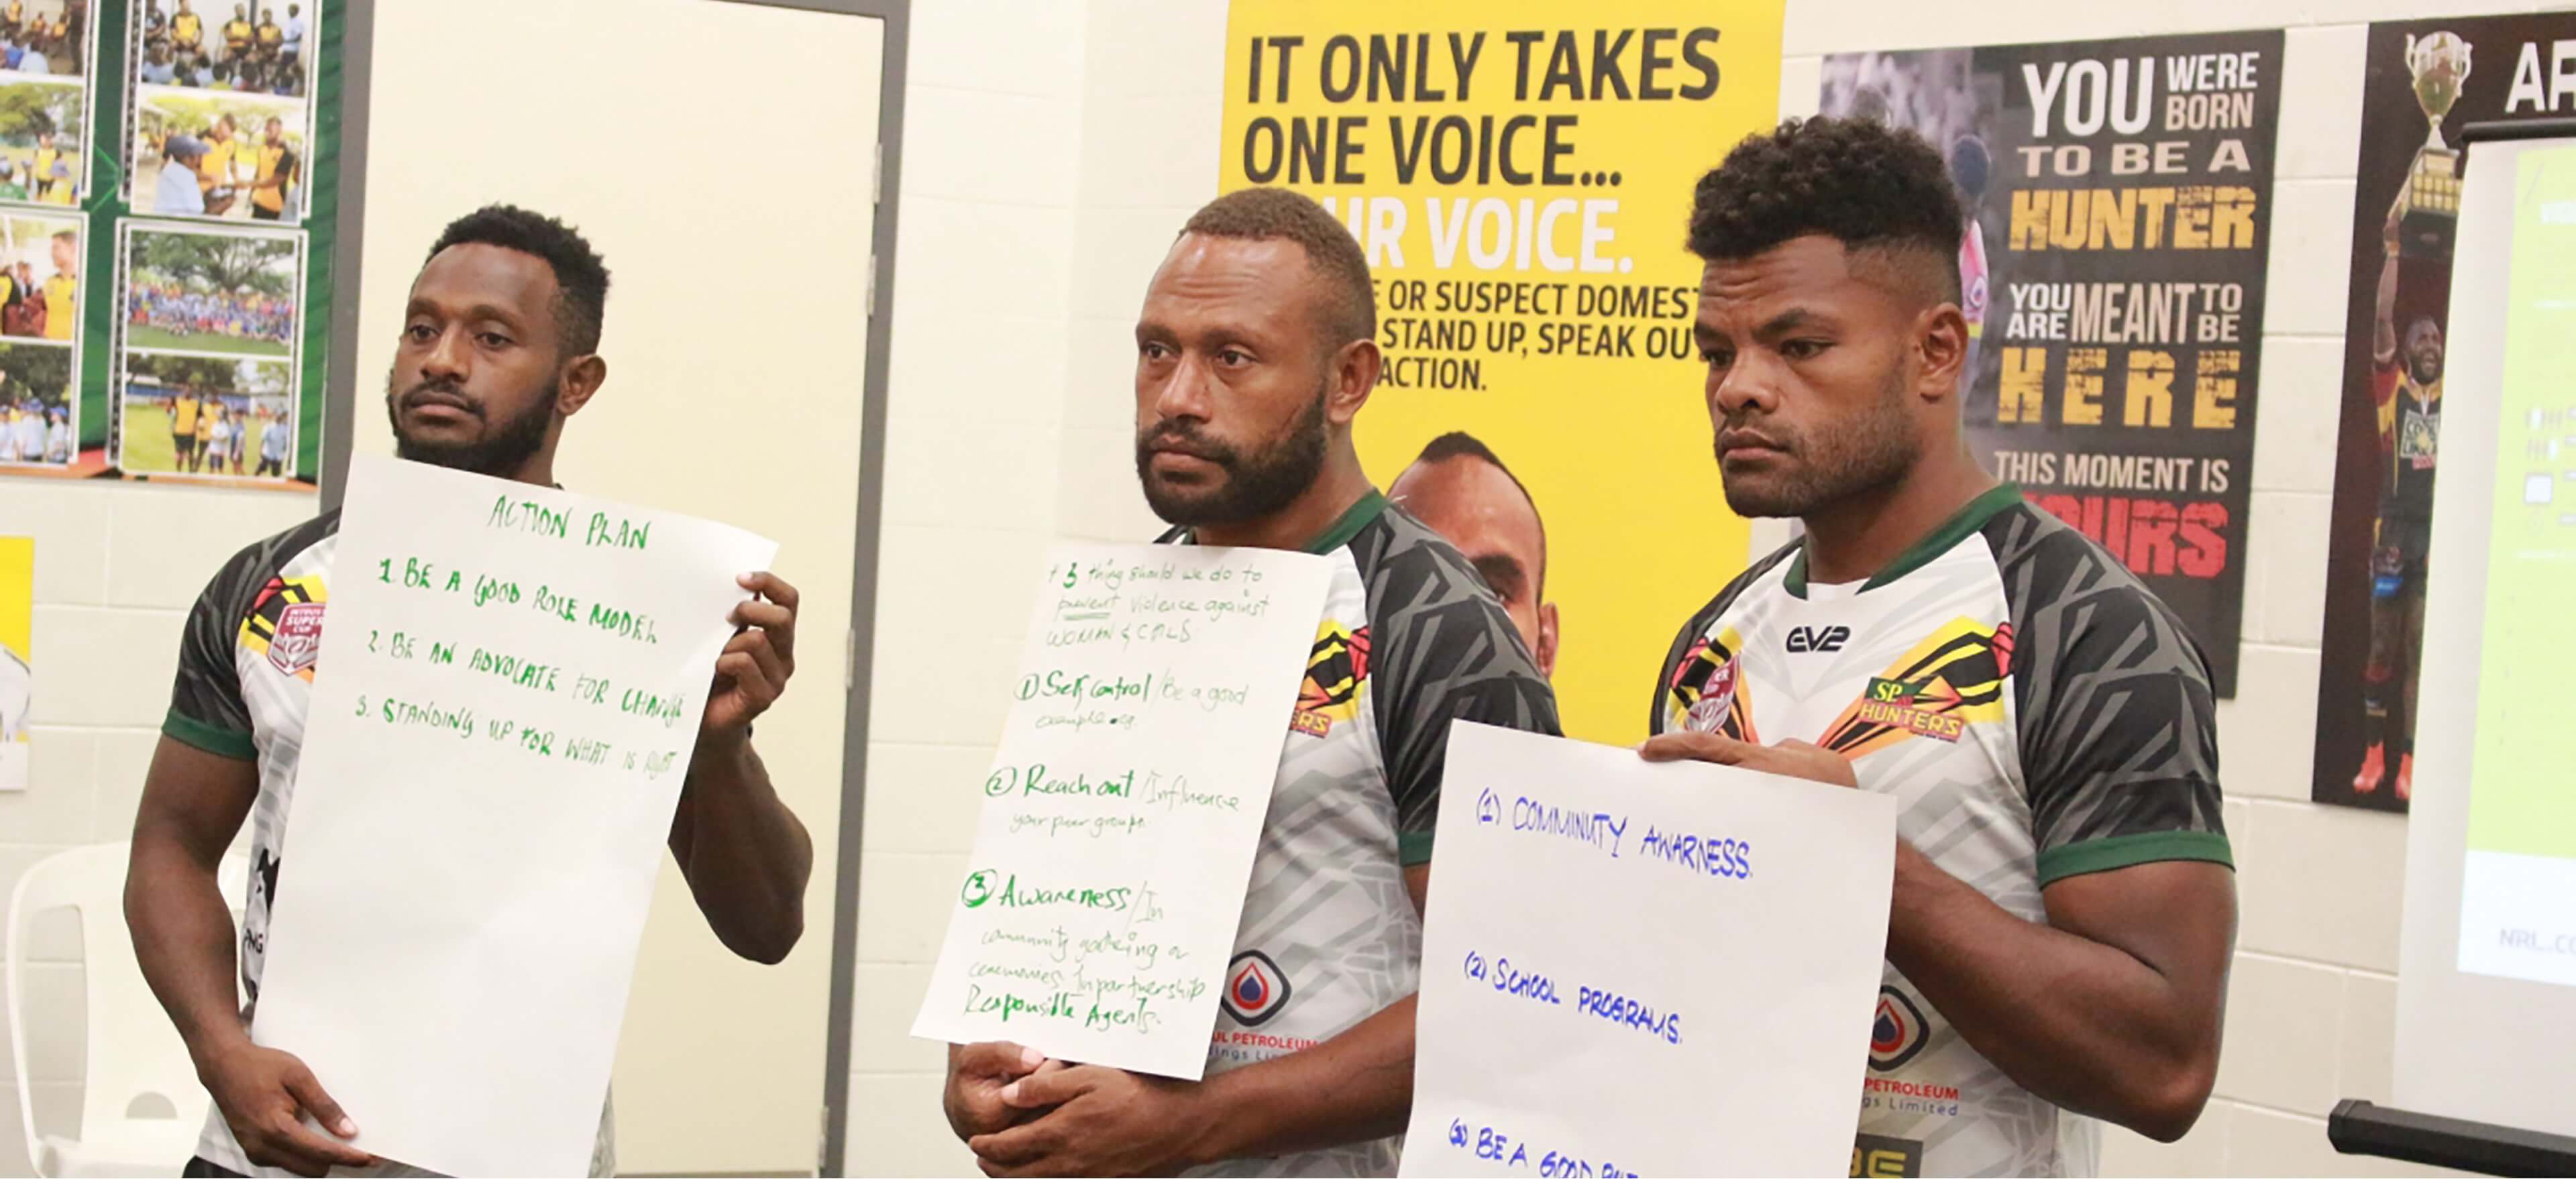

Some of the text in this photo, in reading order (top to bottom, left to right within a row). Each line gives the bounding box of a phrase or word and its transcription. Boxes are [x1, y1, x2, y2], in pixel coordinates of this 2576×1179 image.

[1248, 27, 1721, 103] IT ONLY TAKES
[2167, 52, 2259, 92] WERE
[2506, 40, 2576, 112] AR
[2022, 57, 2154, 137] YOU
[2165, 93, 2255, 131] BORN
[1243, 115, 1623, 187] ONE VOICE...
[2017, 139, 2251, 177] TO BE A
[1323, 196, 1633, 274] UR VOICE.
[2009, 186, 2257, 251] HUNTER
[1389, 280, 1427, 312] OR
[1435, 280, 1568, 317] SUSPECT
[2010, 284, 2071, 312] YOU
[2070, 282, 2196, 343] MEANT
[2198, 284, 2242, 313] TO
[1383, 318, 1691, 361] STAND UP, SPEAK OU
[2007, 313, 2068, 339] ARE
[2197, 314, 2240, 342] BE
[1376, 355, 1487, 392] ACTION.
[1997, 347, 2241, 429] HERE
[1994, 451, 2230, 492] THIS MOMENT IS
[487, 494, 651, 549] ACTION PLAN
[1210, 563, 1232, 581] do
[1242, 563, 1263, 583] to
[404, 557, 433, 589] BE
[445, 571, 462, 592] A
[474, 574, 521, 607] GOOD
[533, 585, 578, 622] ROLE
[590, 603, 657, 644] MODEL
[1786, 625, 1851, 653] EV2
[391, 632, 417, 659] BE
[429, 642, 458, 664] AN
[469, 647, 561, 692] ADVOCATE
[572, 673, 609, 704] FOR
[1874, 681, 1904, 703] SP
[383, 697, 474, 739] STANDING
[489, 719, 515, 740] UP
[519, 727, 555, 756] FOR
[566, 738, 612, 766] WHAT
[1859, 702, 1962, 736] HUNTERS
[1024, 763, 1091, 797] Reach
[1477, 787, 1501, 826] (1)
[999, 874, 1131, 911] Awareness
[1464, 950, 1487, 980] (2)
[1493, 958, 1560, 1005] SCHOOL
[1864, 1077, 1959, 1101] PETROLEUM
[1888, 1097, 1959, 1117] Limited
[1476, 1127, 1507, 1159] BE
[1509, 1142, 1527, 1168] A
